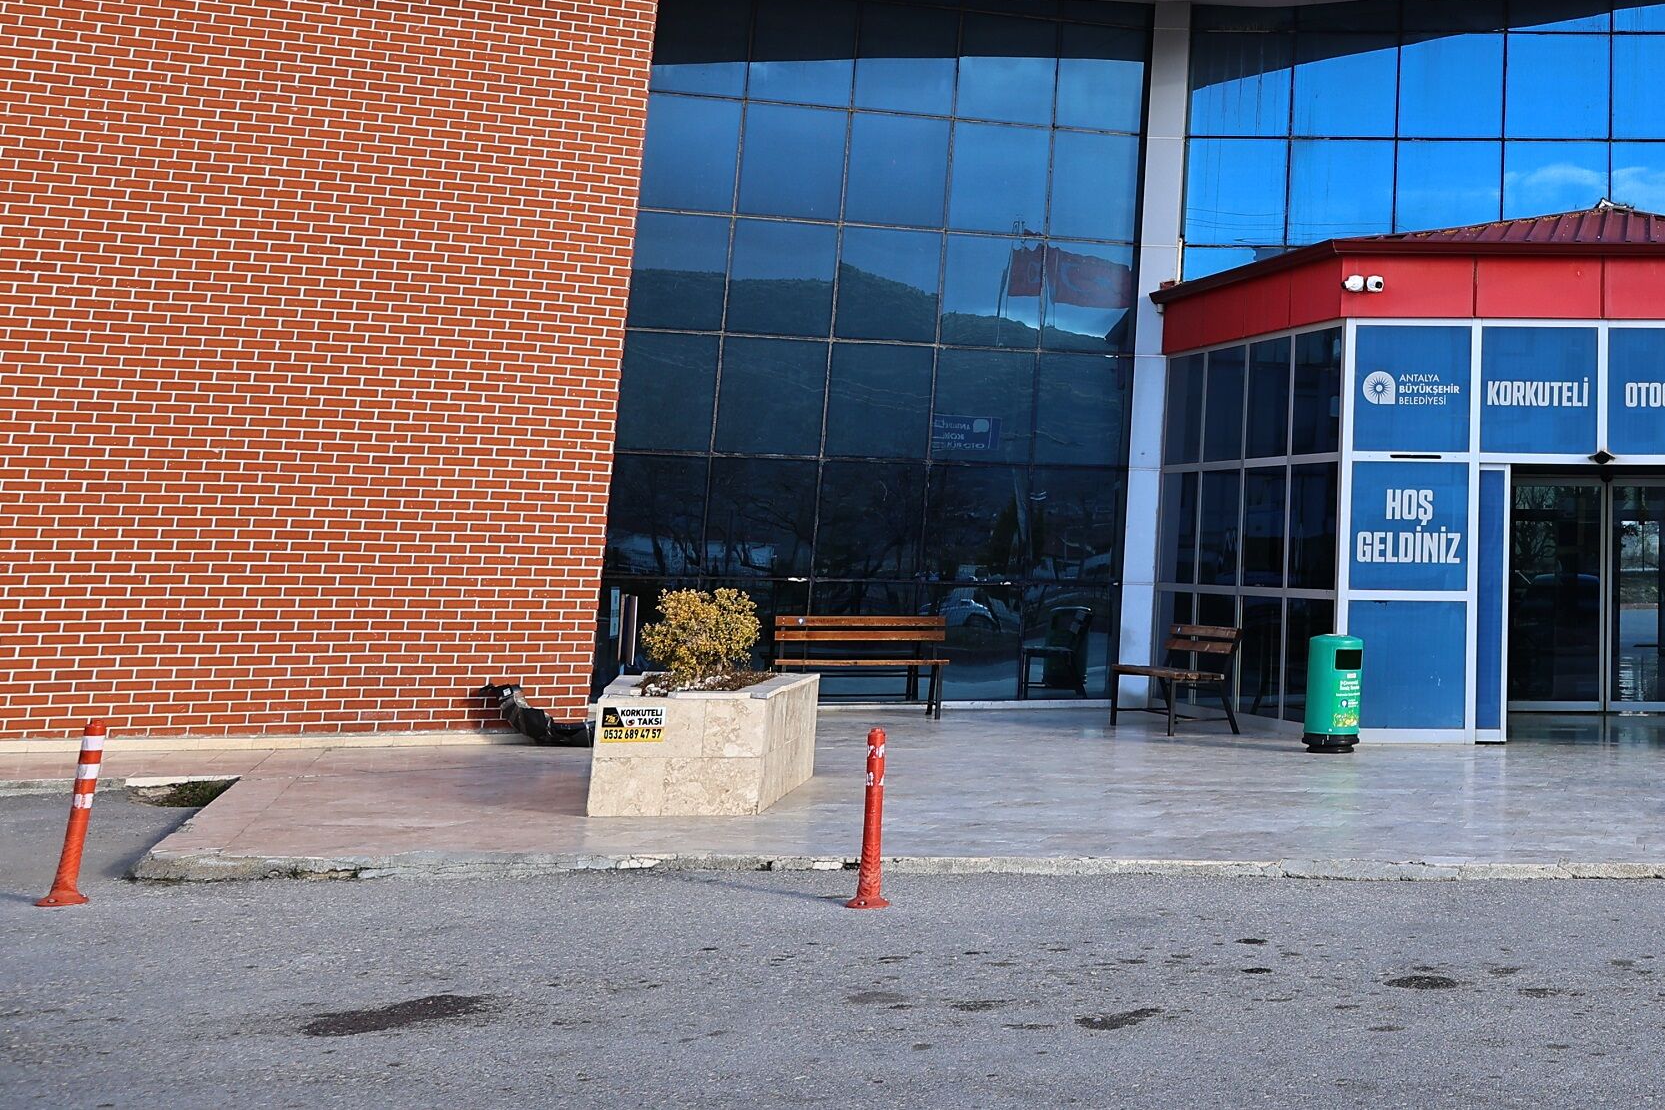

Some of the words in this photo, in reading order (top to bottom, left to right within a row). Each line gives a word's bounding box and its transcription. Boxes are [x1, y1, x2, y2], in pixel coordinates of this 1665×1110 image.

[1398, 374, 1440, 383] ANTALYA
[1398, 383, 1460, 396] BÜYÜKŞEHİR
[1486, 377, 1589, 407] KORKUTELİ
[1398, 395, 1447, 406] BELEDİYESİ
[1385, 489, 1434, 526] HOŞ
[1356, 525, 1461, 564] GELDİNİZ
[638, 717, 663, 726] TAKSİ
[603, 729, 623, 740] 0532
[624, 728, 639, 740] 689
[640, 728, 650, 739] 47
[651, 728, 662, 739] 57
